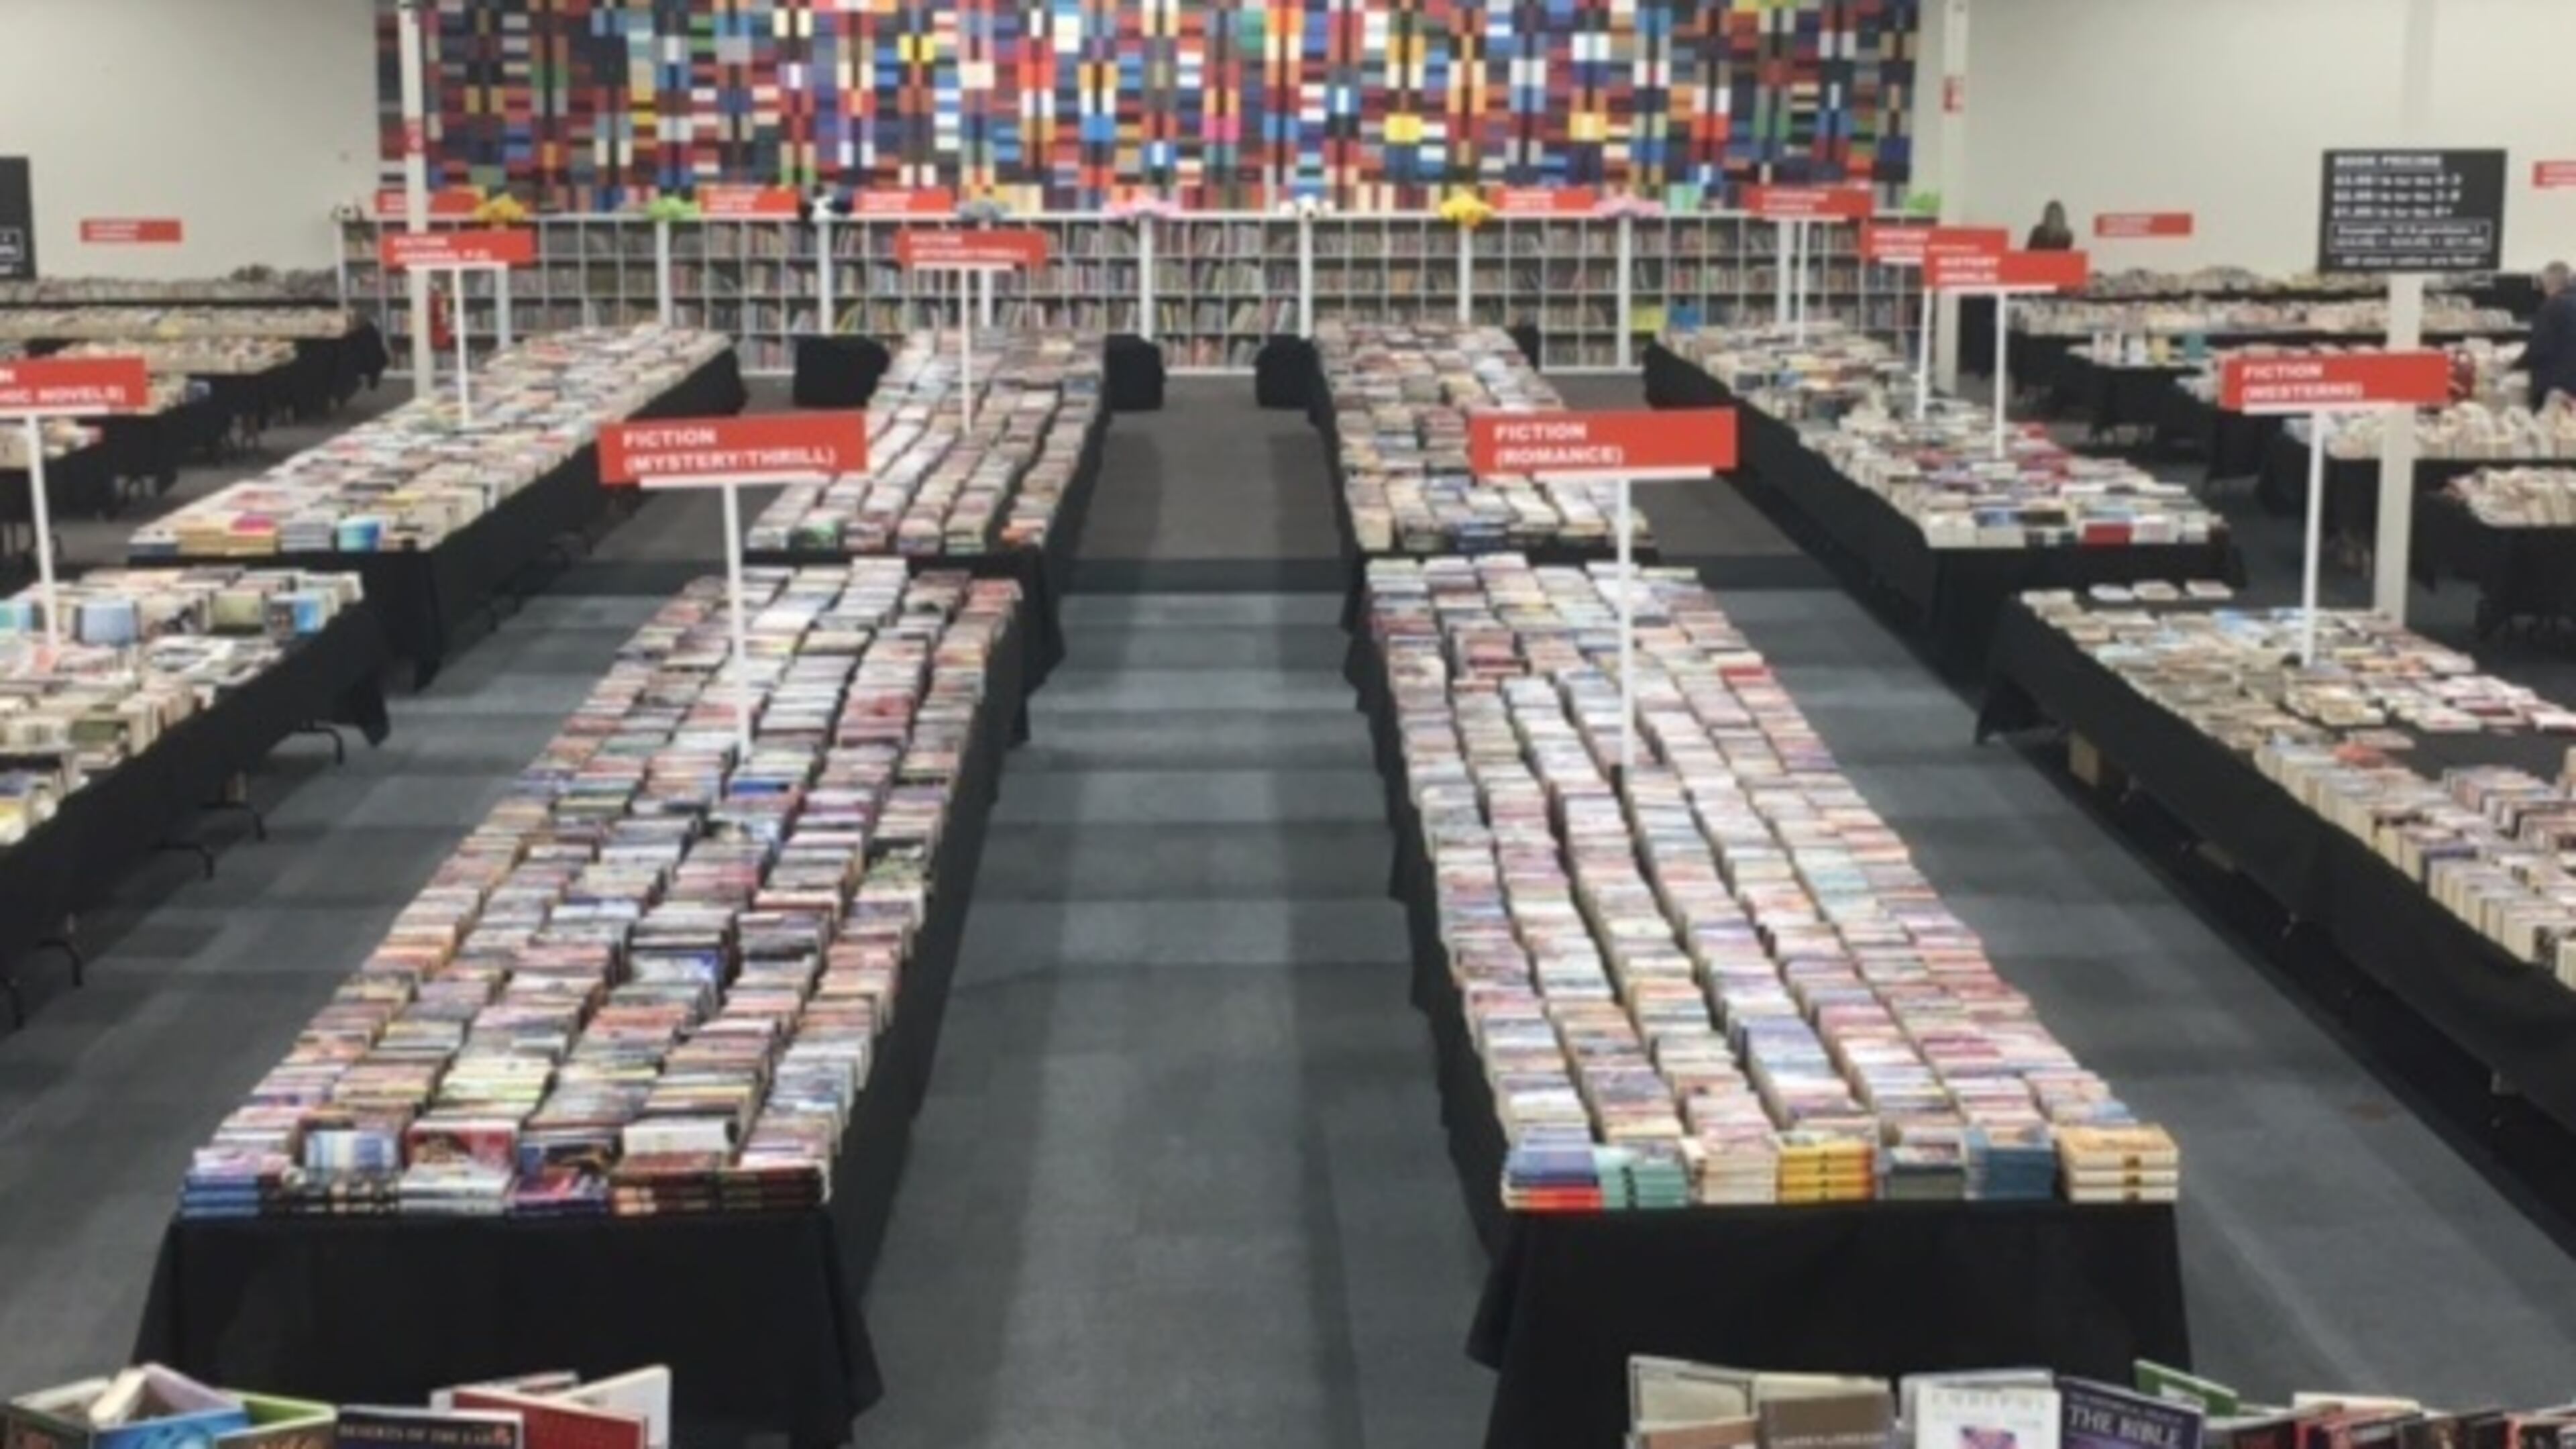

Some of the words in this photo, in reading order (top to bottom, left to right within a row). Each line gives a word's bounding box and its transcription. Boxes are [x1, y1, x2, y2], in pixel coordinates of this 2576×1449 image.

[2381, 155, 2441, 167] PRICING
[2242, 362, 2323, 380] FICTION
[2242, 381, 2365, 401] (WESTERNS)
[623, 425, 717, 448] FICTION
[1493, 422, 1587, 443] FICTION
[1494, 445, 1624, 469] (ROMANCE)
[2068, 1404, 2114, 1434] THE
[2119, 1415, 2184, 1449] BIBLE
